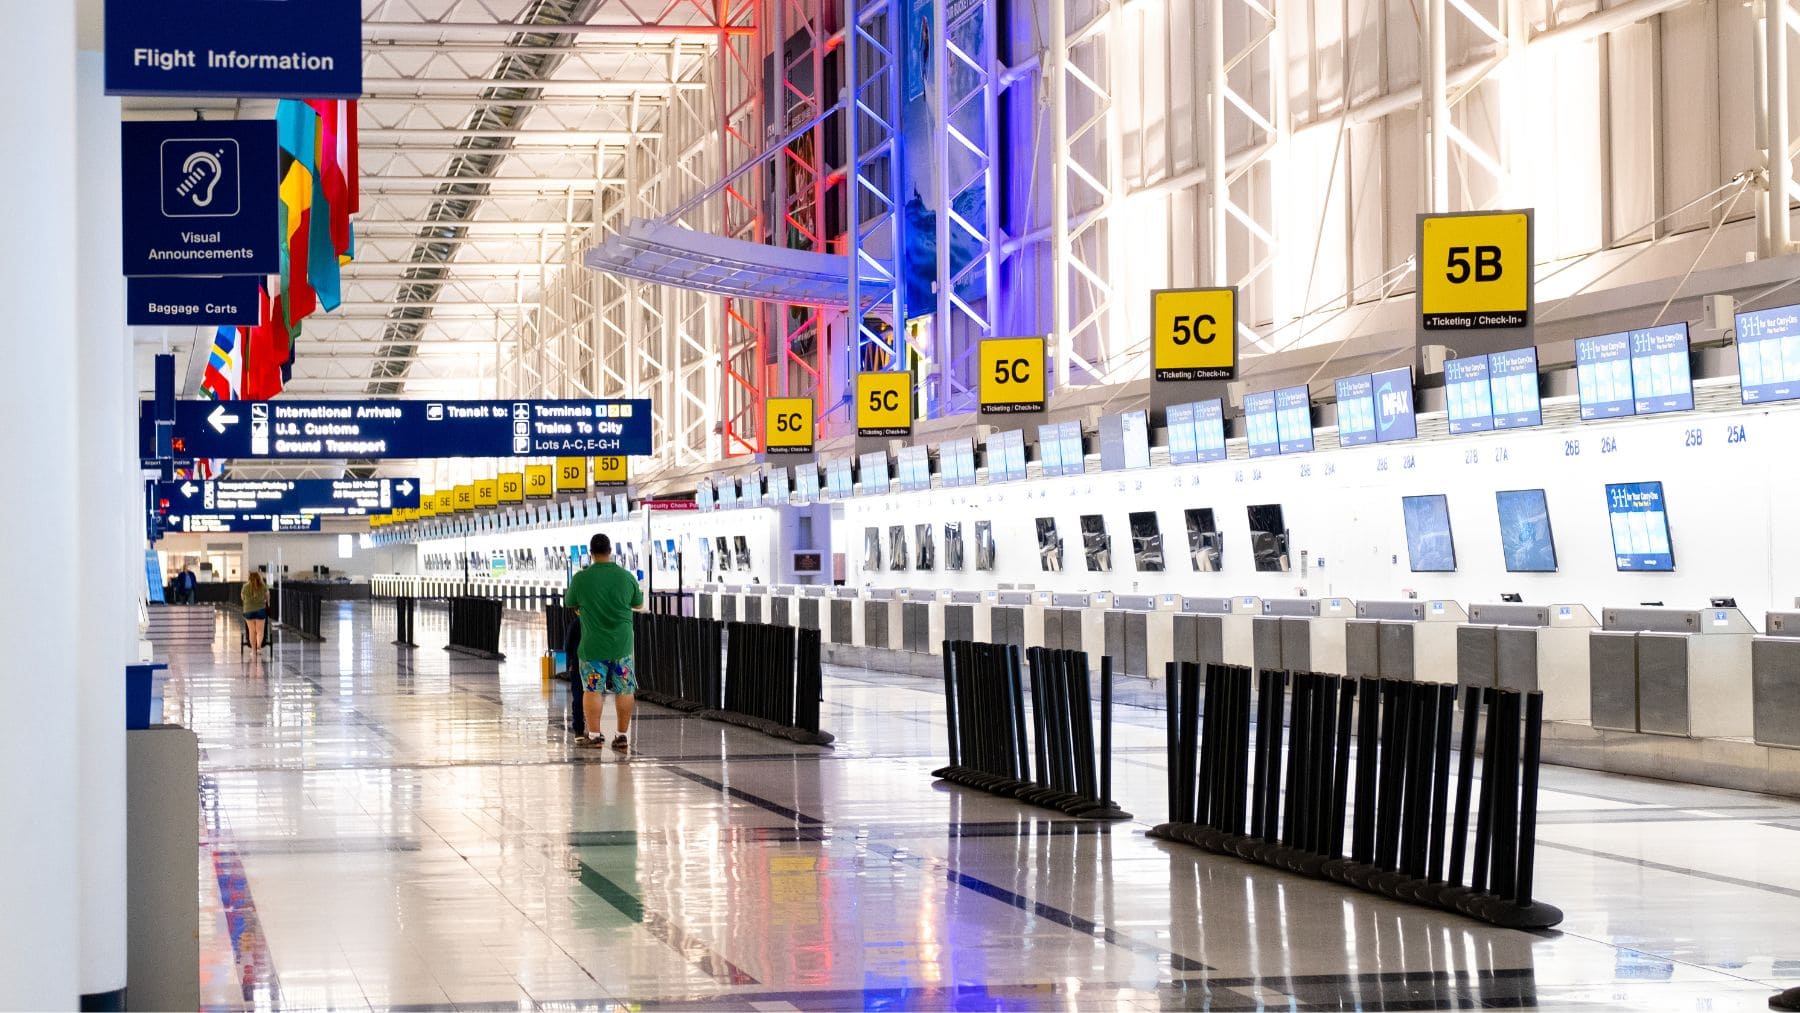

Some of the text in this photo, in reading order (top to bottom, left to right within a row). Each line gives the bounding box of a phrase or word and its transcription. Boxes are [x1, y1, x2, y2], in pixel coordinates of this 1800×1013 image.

[134, 48, 333, 70] Flight Information
[181, 232, 220, 243] Visual
[148, 248, 253, 260] Announcements
[1446, 246, 1503, 284] 5B
[148, 303, 237, 315] Baggage Carts
[1432, 317, 1471, 327] Ticketing
[1478, 314, 1517, 325] Check-In
[1172, 314, 1216, 345] 5C
[994, 358, 1030, 384] 5C
[1163, 371, 1191, 379] Ticketing
[869, 390, 898, 411] 5C
[276, 406, 402, 418] International Arrivals
[448, 406, 508, 417] Transit to:
[535, 405, 592, 417] Terminals
[987, 405, 1010, 413] Ticketing
[777, 413, 802, 431] 5C
[276, 423, 359, 435] U.S. Customs
[535, 423, 623, 435] Trains To City
[1728, 425, 1746, 443] 25A
[1685, 429, 1703, 447] 25B
[276, 440, 386, 453] Ground Transport
[536, 440, 620, 451] Lots A-C,E-G-H
[1565, 437, 1617, 456] 26B 26A
[1465, 447, 1509, 464] 27B 27A
[601, 457, 619, 470] 5D
[563, 467, 579, 479] 5D
[531, 475, 545, 486] 5D
[479, 488, 492, 498] 5E
[503, 482, 517, 492] 5D
[440, 497, 450, 506] 5E
[459, 492, 469, 502] 5E
[423, 501, 433, 510] 5E
